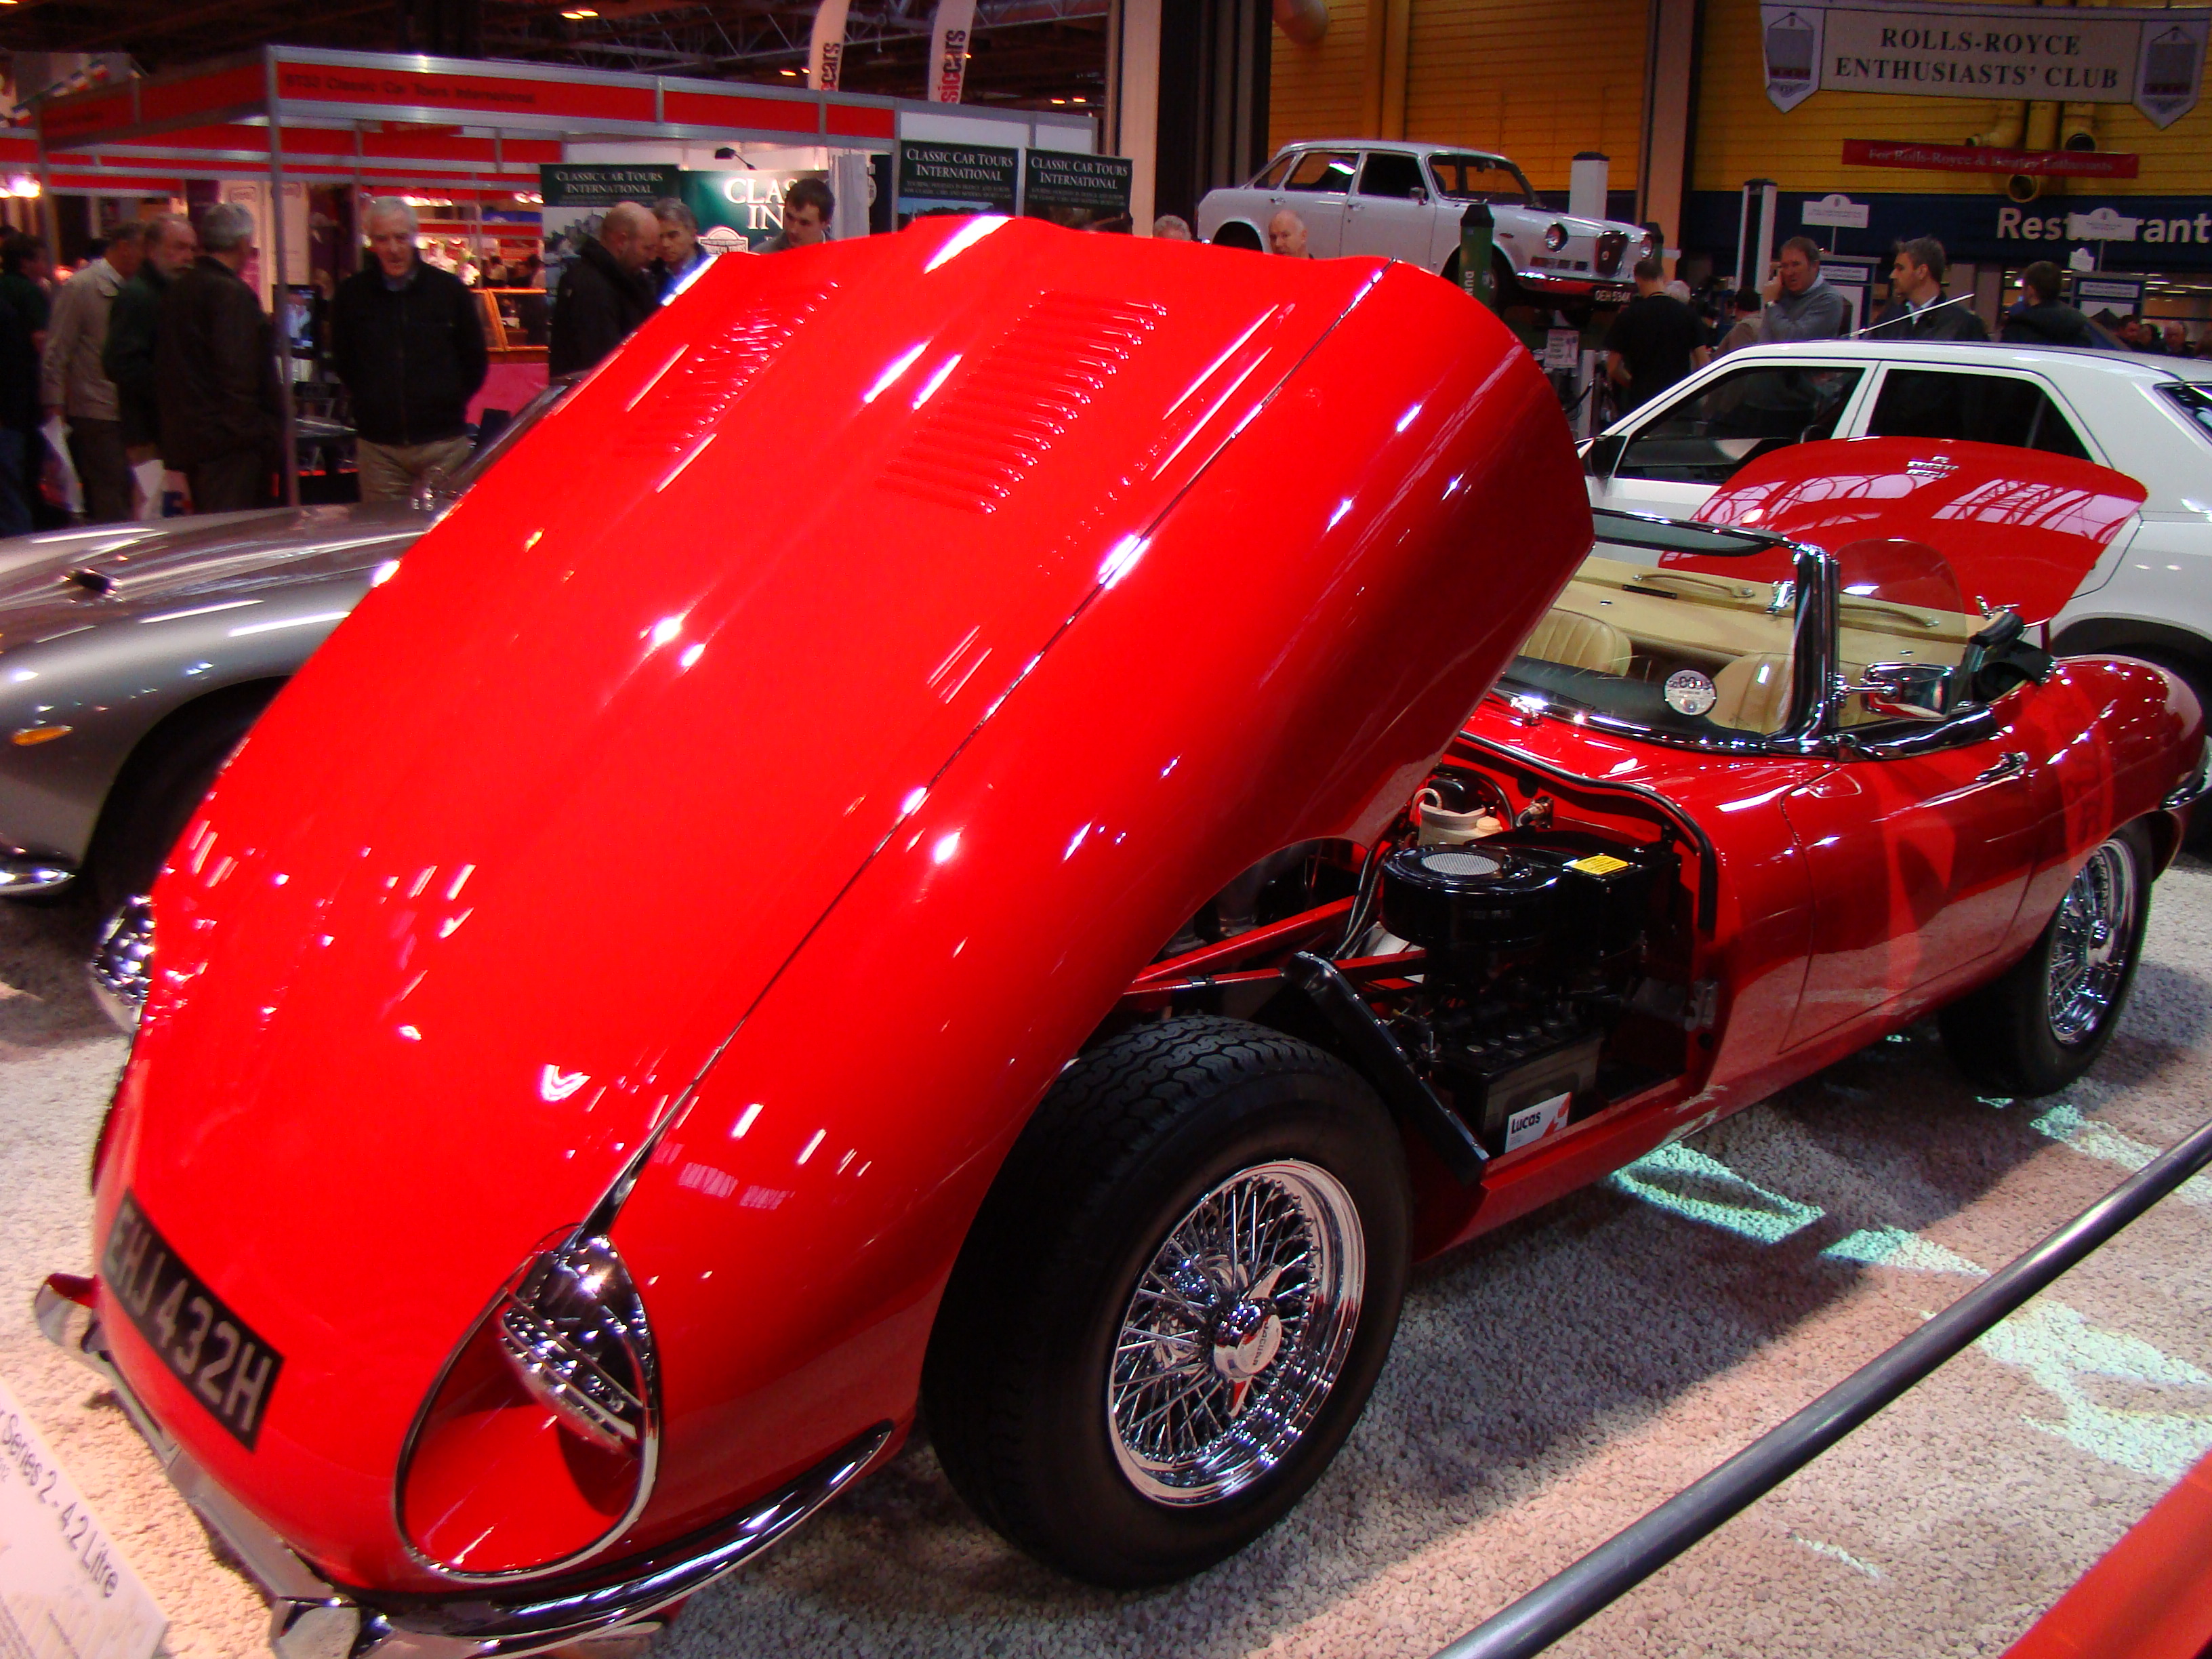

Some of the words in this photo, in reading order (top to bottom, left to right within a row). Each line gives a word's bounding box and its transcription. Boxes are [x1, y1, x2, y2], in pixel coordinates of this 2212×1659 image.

[1881, 28, 2082, 56] ROLLS-ROYCE
[1835, 56, 2036, 85] ENTHUSIASTS'
[2044, 66, 2118, 89] CLUB
[455, 87, 536, 104] International
[907, 148, 951, 163] CLASSIC
[953, 151, 976, 165] CAR
[977, 153, 1013, 168] TOURS
[1031, 157, 1072, 171] CLASSIC
[1073, 161, 1094, 173] CAR
[1094, 162, 1129, 177] TOURS
[1868, 148, 1888, 161] For
[1893, 149, 1969, 167] Rolls-Royce
[1975, 154, 1985, 166] &
[554, 171, 601, 182] CLASSIC
[602, 171, 624, 182] CAR
[626, 171, 663, 182] TOURS
[916, 164, 1003, 182] INTERNATIONAL
[1040, 171, 1118, 190] INTERNATIONAL
[566, 183, 655, 194] INTERNATIONAL
[1997, 207, 2212, 244] Resrant
[1511, 1111, 1542, 1135] Lucas
[1253, 1321, 1269, 1366] JAGUAR
[156, 1277, 273, 1432] 432H
[1, 1414, 43, 1486] Series
[37, 1469, 58, 1504] 2
[80, 1530, 119, 1598] Litre
